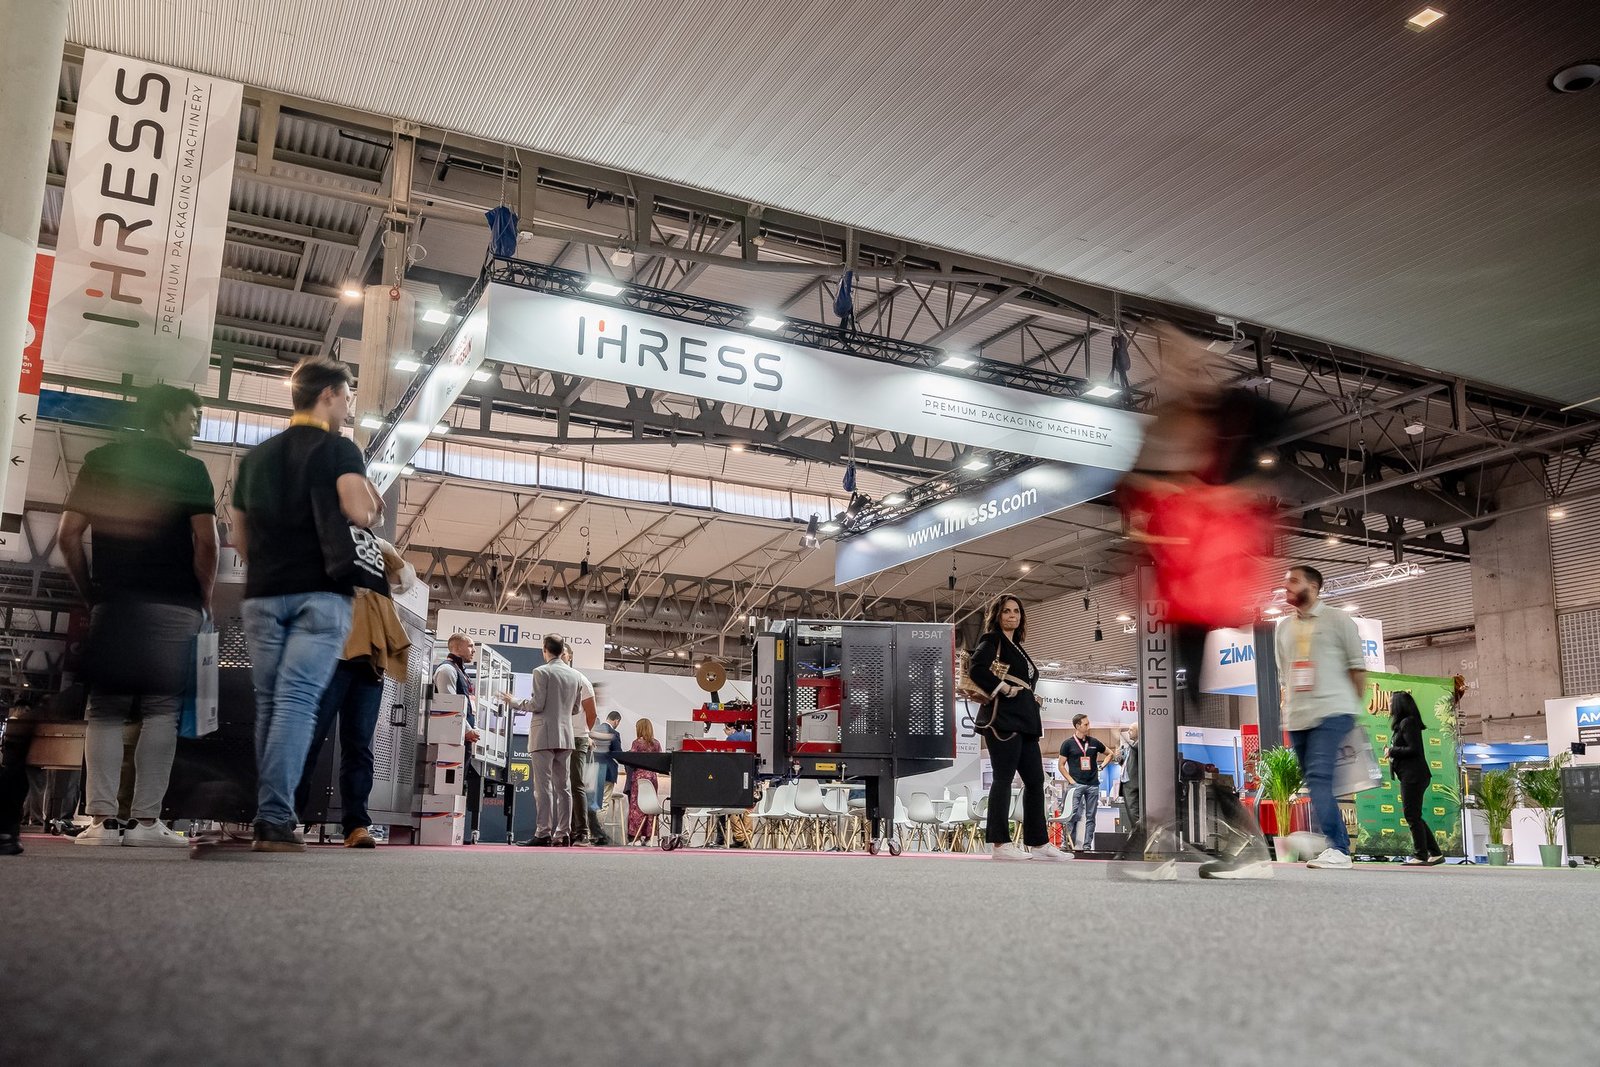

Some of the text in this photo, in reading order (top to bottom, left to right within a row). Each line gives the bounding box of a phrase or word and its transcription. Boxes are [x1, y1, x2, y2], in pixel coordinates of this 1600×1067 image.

[82, 67, 170, 328] IHRESS
[162, 84, 204, 333] PREMIUM PACKAGING MACHINERY
[577, 316, 783, 392] IHRESS
[925, 399, 1108, 441] PREMIUM PACKAGING MACHINERY
[453, 625, 496, 637] INSER
[760, 674, 772, 735] IHRESS
[1121, 700, 1138, 712] AB
